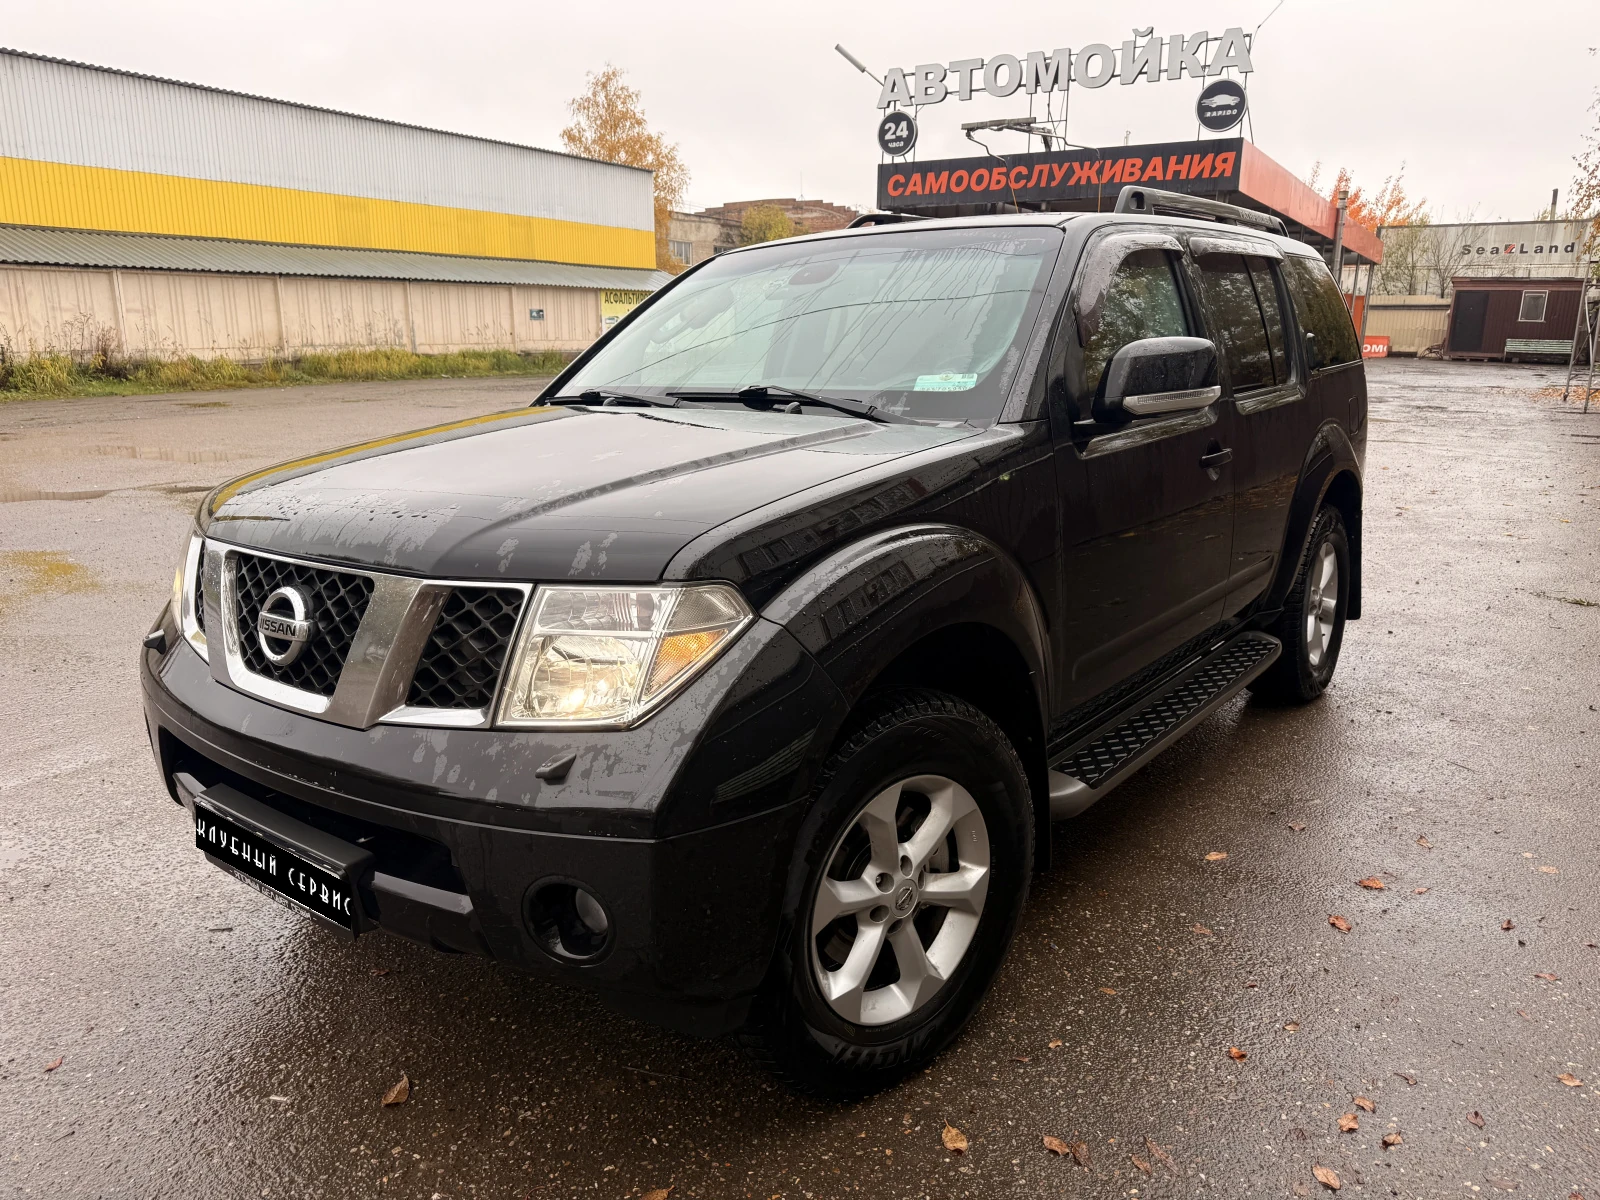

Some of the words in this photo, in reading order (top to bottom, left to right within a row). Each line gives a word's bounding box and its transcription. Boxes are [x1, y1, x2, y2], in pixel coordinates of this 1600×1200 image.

[877, 26, 1253, 110] АВТОМОЙКА
[1204, 109, 1238, 118] RAPIDO
[884, 120, 908, 140] 24
[887, 151, 1236, 196] САМООБСЛУЖИВАНИЯ
[1461, 244, 1500, 255] Sea
[1519, 242, 1576, 255] Land
